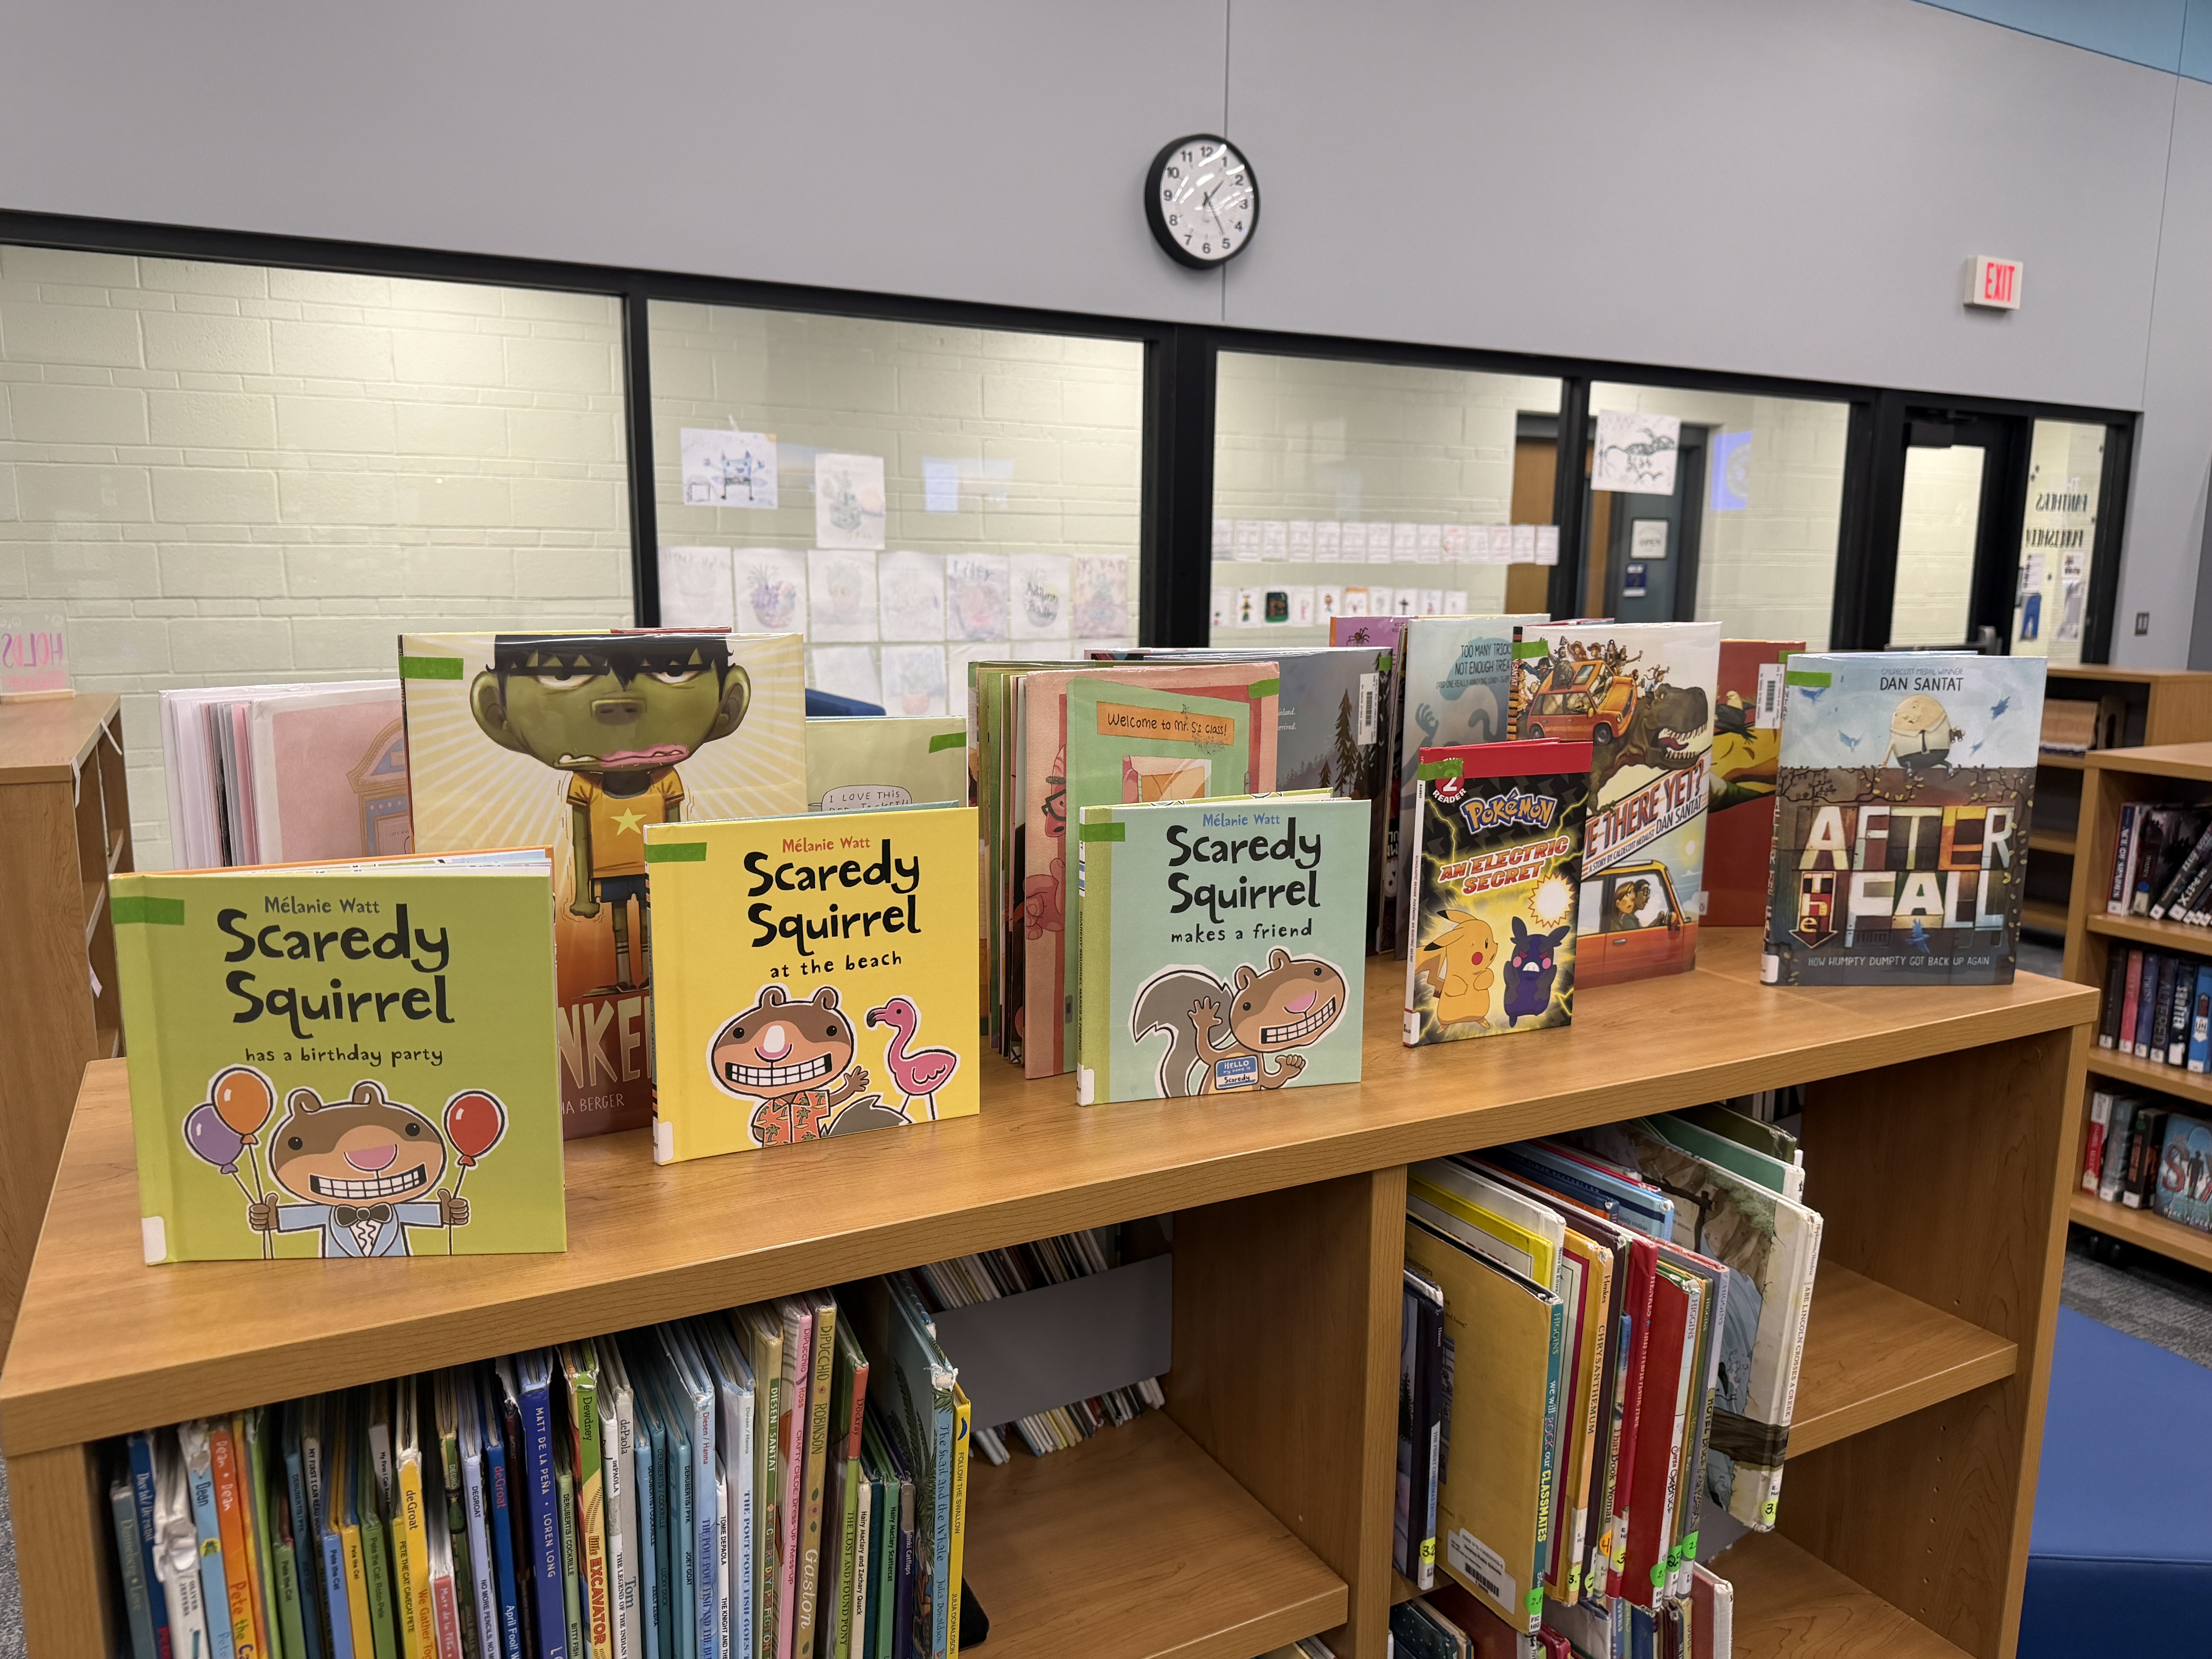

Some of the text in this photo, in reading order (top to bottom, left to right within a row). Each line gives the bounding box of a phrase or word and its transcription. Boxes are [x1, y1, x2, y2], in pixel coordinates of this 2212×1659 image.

[1181, 151, 1193, 163] 11
[1200, 147, 1213, 157] 12
[1222, 157, 1227, 167] 1
[1167, 167, 1179, 179] 10
[1235, 175, 1243, 186] 2
[1164, 190, 1172, 201] 9
[1240, 199, 1248, 209] 3
[1169, 215, 1178, 226] 8
[1235, 222, 1242, 232] 4
[1184, 234, 1192, 246] 7
[1202, 243, 1211, 254] 6
[1222, 238, 1230, 249] 5
[1985, 262, 2015, 302] EXIT
[1880, 677, 1964, 691] DAN SANTAT
[1108, 713, 1157, 729] Welcome
[1161, 719, 1171, 730] to
[1175, 720, 1188, 731] Mr.
[842, 792, 870, 801] LOVE
[1433, 788, 1467, 804] READER
[1443, 769, 1458, 792] 2
[1203, 813, 1280, 827] Mélanie Watt
[1603, 784, 1661, 849] THERE
[1664, 759, 1704, 813] YET?
[782, 836, 871, 853] Mélanie Watt
[1166, 817, 1321, 869] Scaredy
[1593, 856, 1606, 871] STORY
[1607, 853, 1613, 864] BY
[1613, 841, 1636, 859] CALDECOTT
[1636, 829, 1655, 848] MEDALIST
[1656, 813, 1673, 835] DAN
[1675, 794, 1703, 823] SANTAT
[1798, 806, 2015, 871] AFTER
[744, 839, 920, 897] Scaredy
[1439, 837, 1569, 881] AN ELECTRIC
[1463, 860, 1545, 894] SECRET
[265, 896, 380, 914] Mélanie Watt
[1168, 871, 1321, 924] Squirrel
[1844, 871, 2004, 948] FALL
[217, 903, 450, 973] Scaredy
[747, 895, 922, 956] Squirrel
[1171, 918, 1312, 943] makes a friend
[770, 951, 902, 978] at the beach
[1808, 956, 1990, 966] HOW HUMPTY DUMPTY GOT BACK UP AGAIN
[226, 971, 455, 1039] Squirrel
[246, 1044, 443, 1067] has a birthday party
[1224, 1061, 1249, 1069] HELLO
[1224, 1074, 1250, 1083] Scaredy
[580, 1094, 624, 1112] BERGER
[1687, 1299, 1698, 1339] HIGGINS
[1702, 1298, 1711, 1331] HIGGINS
[1718, 1285, 1727, 1325] HIGGINS
[1552, 1312, 1561, 1355] HIGGINS
[1796, 1304, 1808, 1344] LINCOLN
[1587, 1275, 1610, 1434] Henkes CHRYSANTHEMUM
[1790, 1345, 1801, 1380] CROSSES
[811, 1326, 832, 1456] DIPUCCHIO ROBINSON
[1785, 1389, 1794, 1417] CREEK
[583, 1397, 592, 1441] Dewdney
[768, 1387, 778, 1472] DIESEN SANTAT
[855, 1398, 864, 1436] Dockray
[1537, 1381, 1556, 1542] we will ROCK our CLASSMATES
[1604, 1428, 1621, 1523] That Book Woman
[195, 1480, 212, 1507] Dean
[471, 1486, 481, 1518] DEGROAT
[494, 1466, 507, 1508] deGroat
[536, 1407, 556, 1578] MATT DE LA PEÑA LOREN LONG
[405, 1489, 418, 1530] deGroat
[954, 1499, 962, 1534] SWALLOW
[858, 1529, 866, 1553] Maclary
[888, 1525, 896, 1548] Maclary
[856, 1568, 864, 1593] Zachary
[886, 1550, 895, 1582] Scattercat
[588, 1535, 606, 1646] little EXCAVATOR
[625, 1575, 637, 1609] Tom
[801, 1548, 818, 1629] Gaston
[503, 1604, 520, 1650] April Fool!
[948, 1612, 957, 1654] DONALDSON
